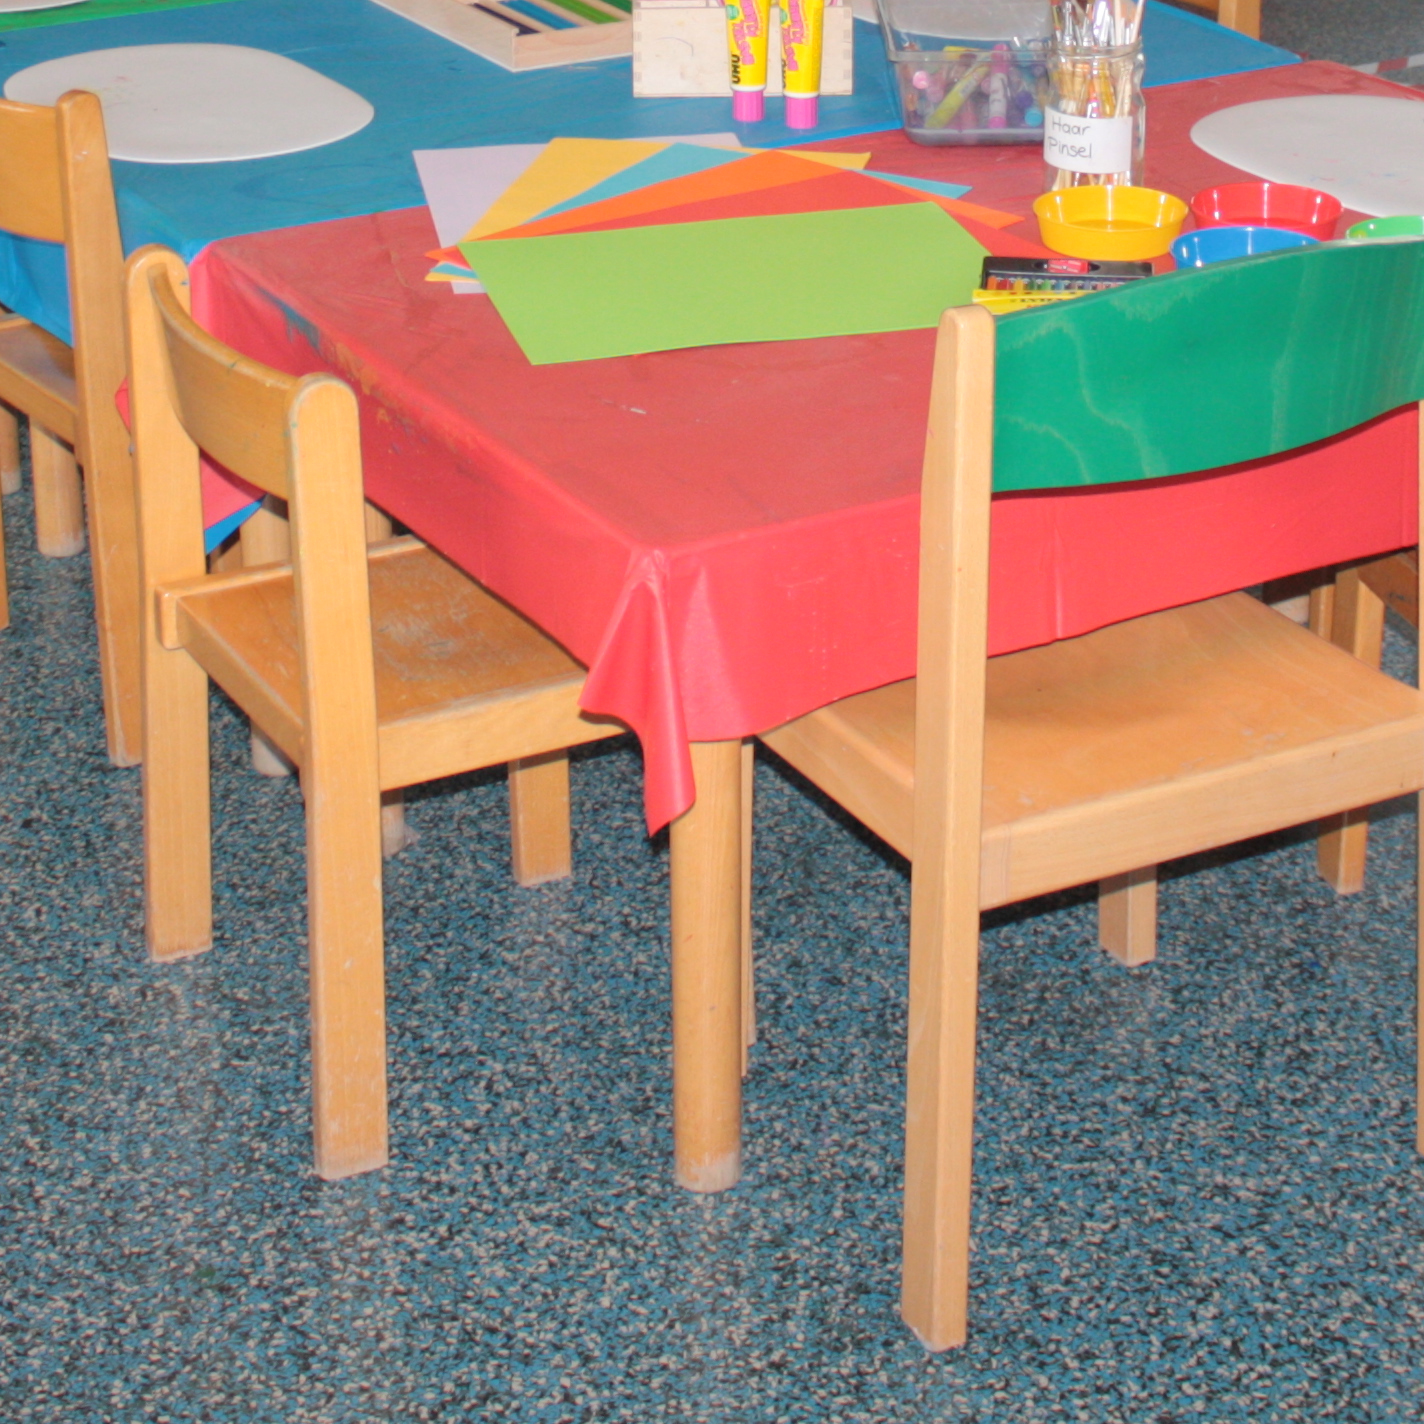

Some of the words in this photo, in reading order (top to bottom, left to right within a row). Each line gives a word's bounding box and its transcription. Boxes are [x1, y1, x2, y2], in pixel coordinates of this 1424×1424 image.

[731, 53, 741, 85] UHU
[1052, 116, 1091, 135] Haar
[1047, 136, 1092, 159] Pinsel
